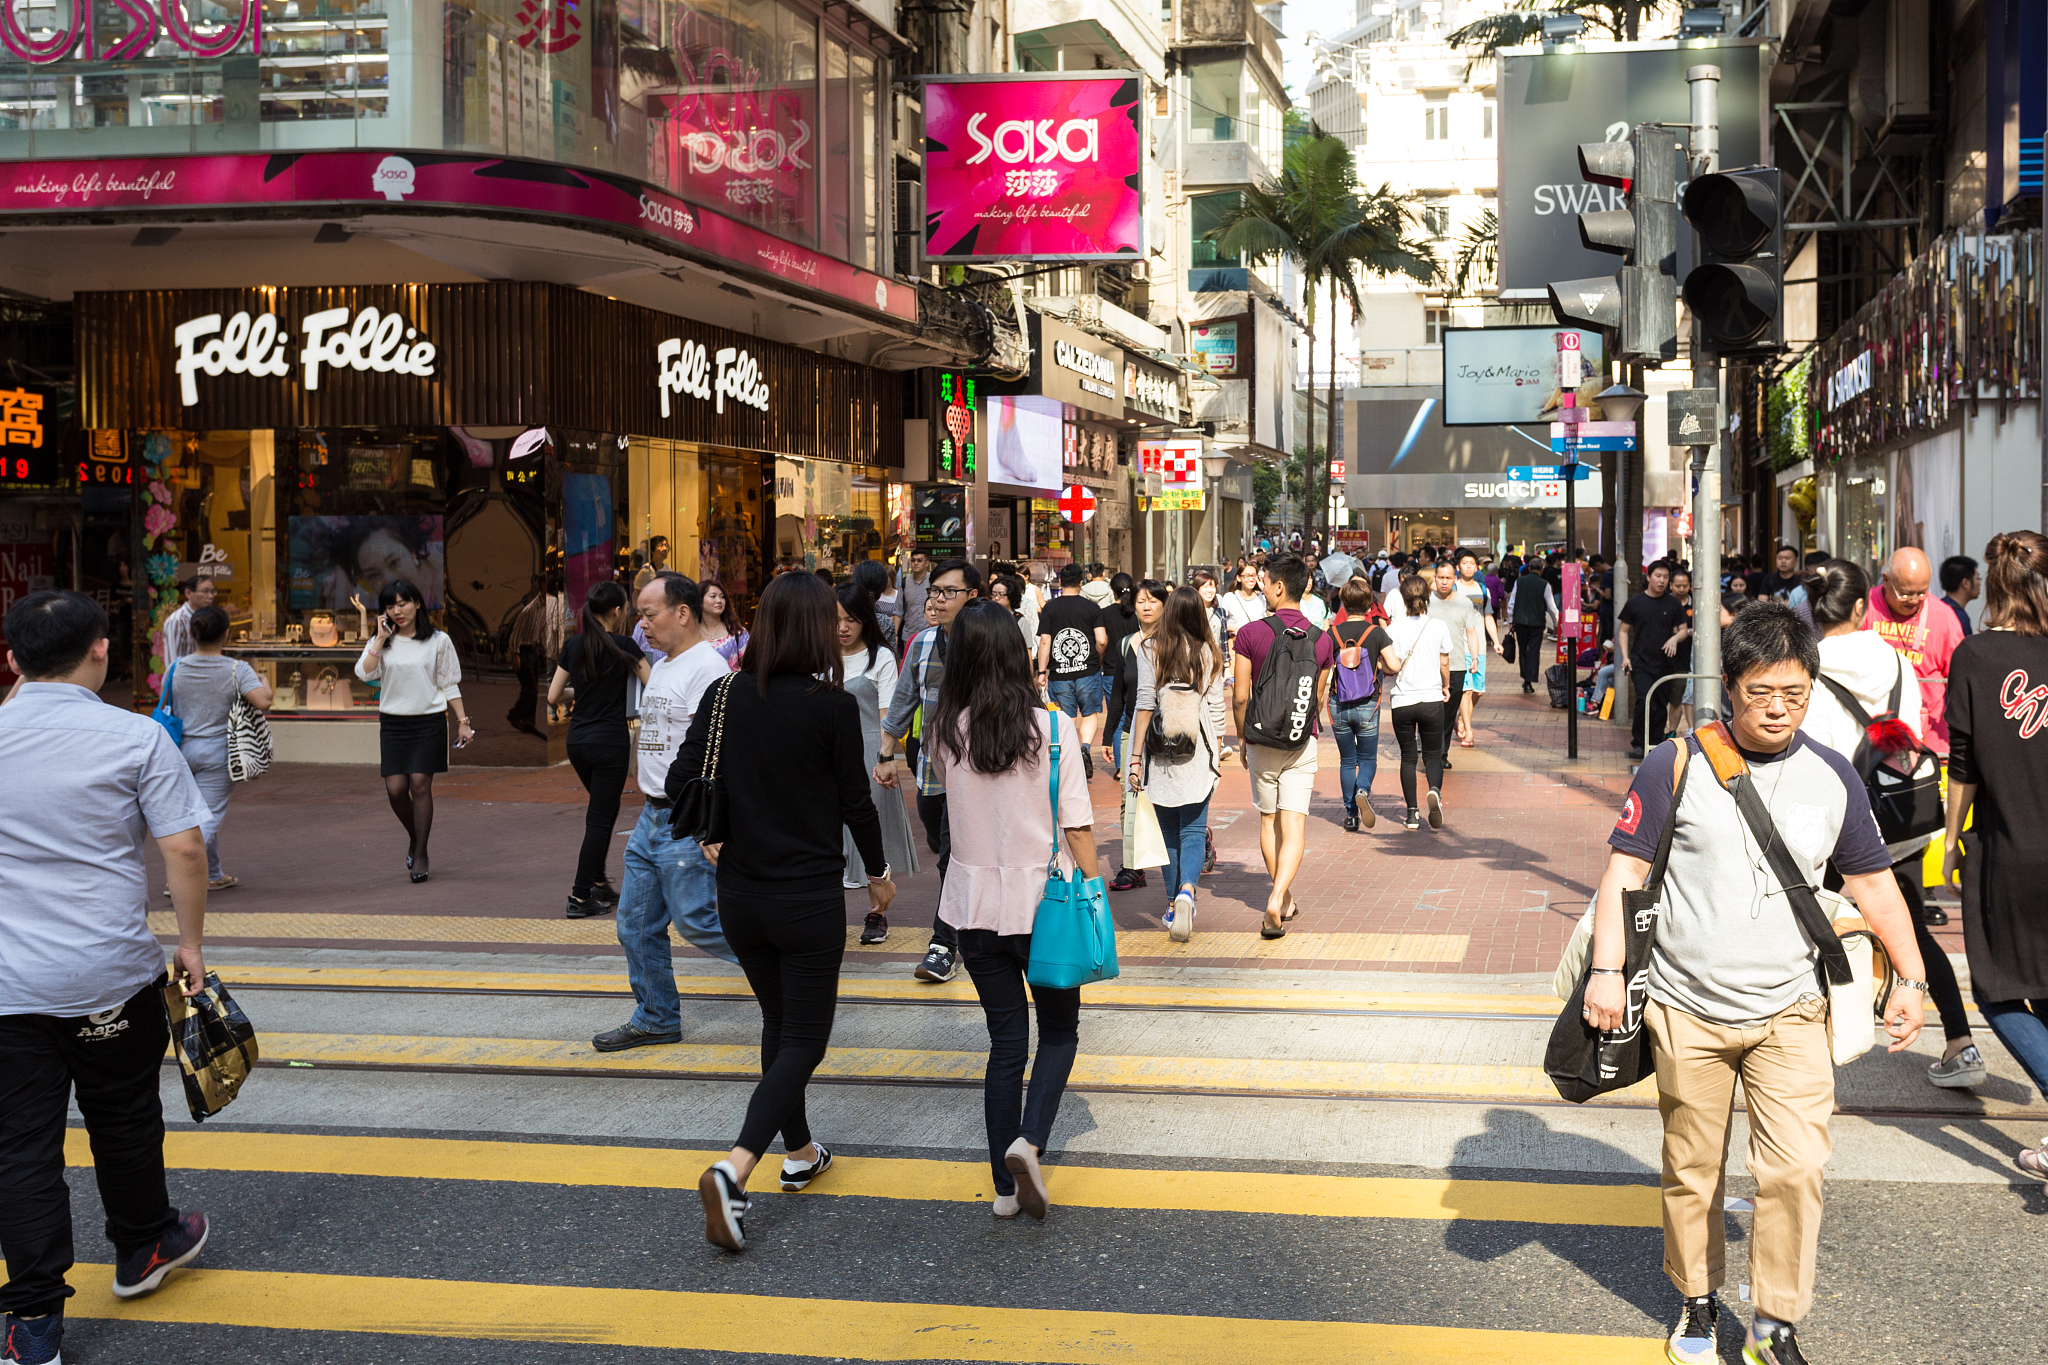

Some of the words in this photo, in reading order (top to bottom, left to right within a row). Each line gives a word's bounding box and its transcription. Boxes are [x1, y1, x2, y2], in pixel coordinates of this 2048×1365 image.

[966, 112, 1098, 164] Sasa
[14, 174, 68, 202] making
[72, 172, 102, 201] life
[106, 171, 175, 199] beautiful
[1005, 169, 1058, 197] 莎莎
[639, 194, 672, 228] Sasa
[974, 205, 1014, 224] making
[1016, 204, 1037, 223] life
[1040, 204, 1090, 223] beautiful
[174, 311, 290, 407] Folli
[301, 306, 436, 390] Follie
[1056, 339, 1116, 385] CALZEDONIA
[658, 338, 711, 418] Folli
[715, 347, 769, 411] Follie
[1457, 365, 1540, 383] Joy&Mario
[1464, 480, 1543, 498] swatch
[1, 549, 42, 583] Nail
[199, 543, 228, 563] Be
[1289, 675, 1313, 741] adidas
[77, 1019, 130, 1038] Aape
